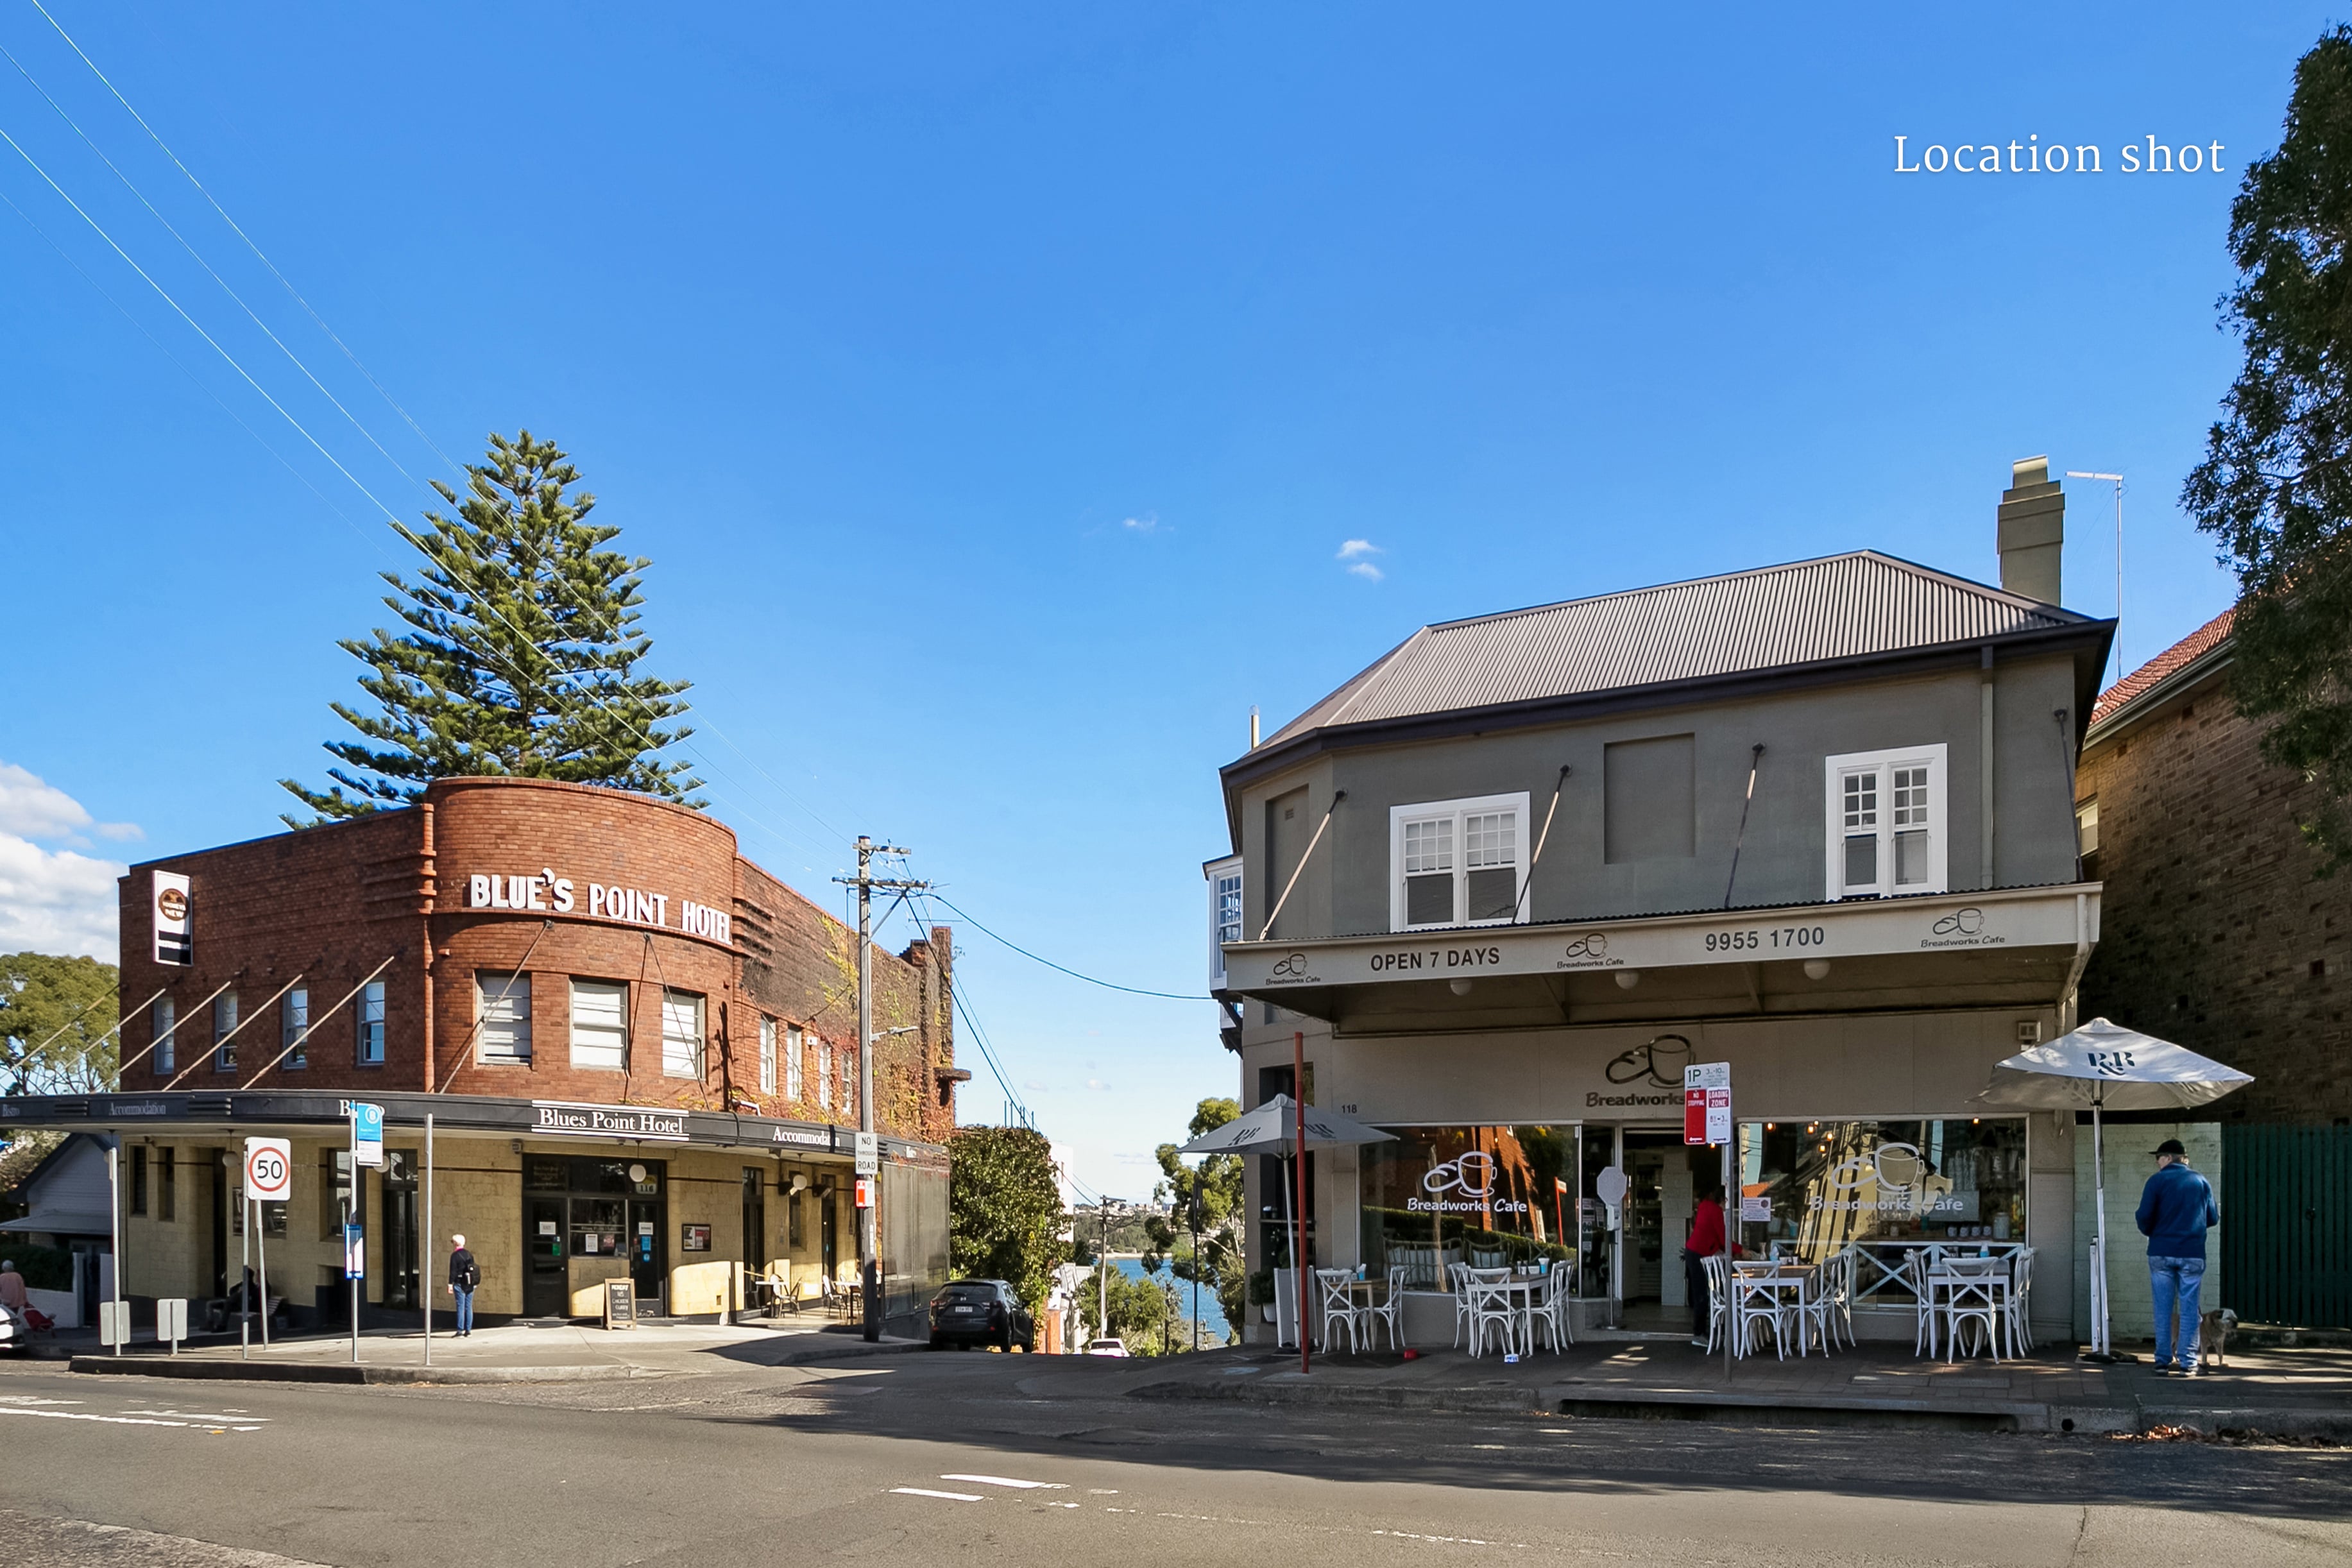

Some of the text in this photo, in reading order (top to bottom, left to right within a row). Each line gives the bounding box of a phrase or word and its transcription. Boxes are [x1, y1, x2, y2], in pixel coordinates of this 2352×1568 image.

[165, 909, 184, 917] NEW
[470, 867, 733, 946] BLUE'S POINT HOTEL
[1705, 926, 1825, 951] 9955 1700
[1921, 935, 2006, 948] Breadworks Cafe
[1370, 947, 1501, 971] OPEN 7 DAYS
[1557, 958, 1624, 969] Breadworks Cafe
[1688, 1069, 1701, 1082] 1P
[1585, 1092, 1685, 1107] Breadworks
[1709, 1091, 1728, 1099] LOADING
[110, 1100, 166, 1116] Accommodation
[1342, 1104, 1358, 1114] 118
[539, 1108, 683, 1134] Blues Point Hotel
[772, 1126, 840, 1146] Accommodatn
[862, 1137, 871, 1145] NO
[257, 1160, 282, 1179] 50
[857, 1161, 876, 1170] ROAD
[1407, 1197, 1527, 1212] Breadworks Cafe
[1809, 1195, 1916, 1211] Breadworks
